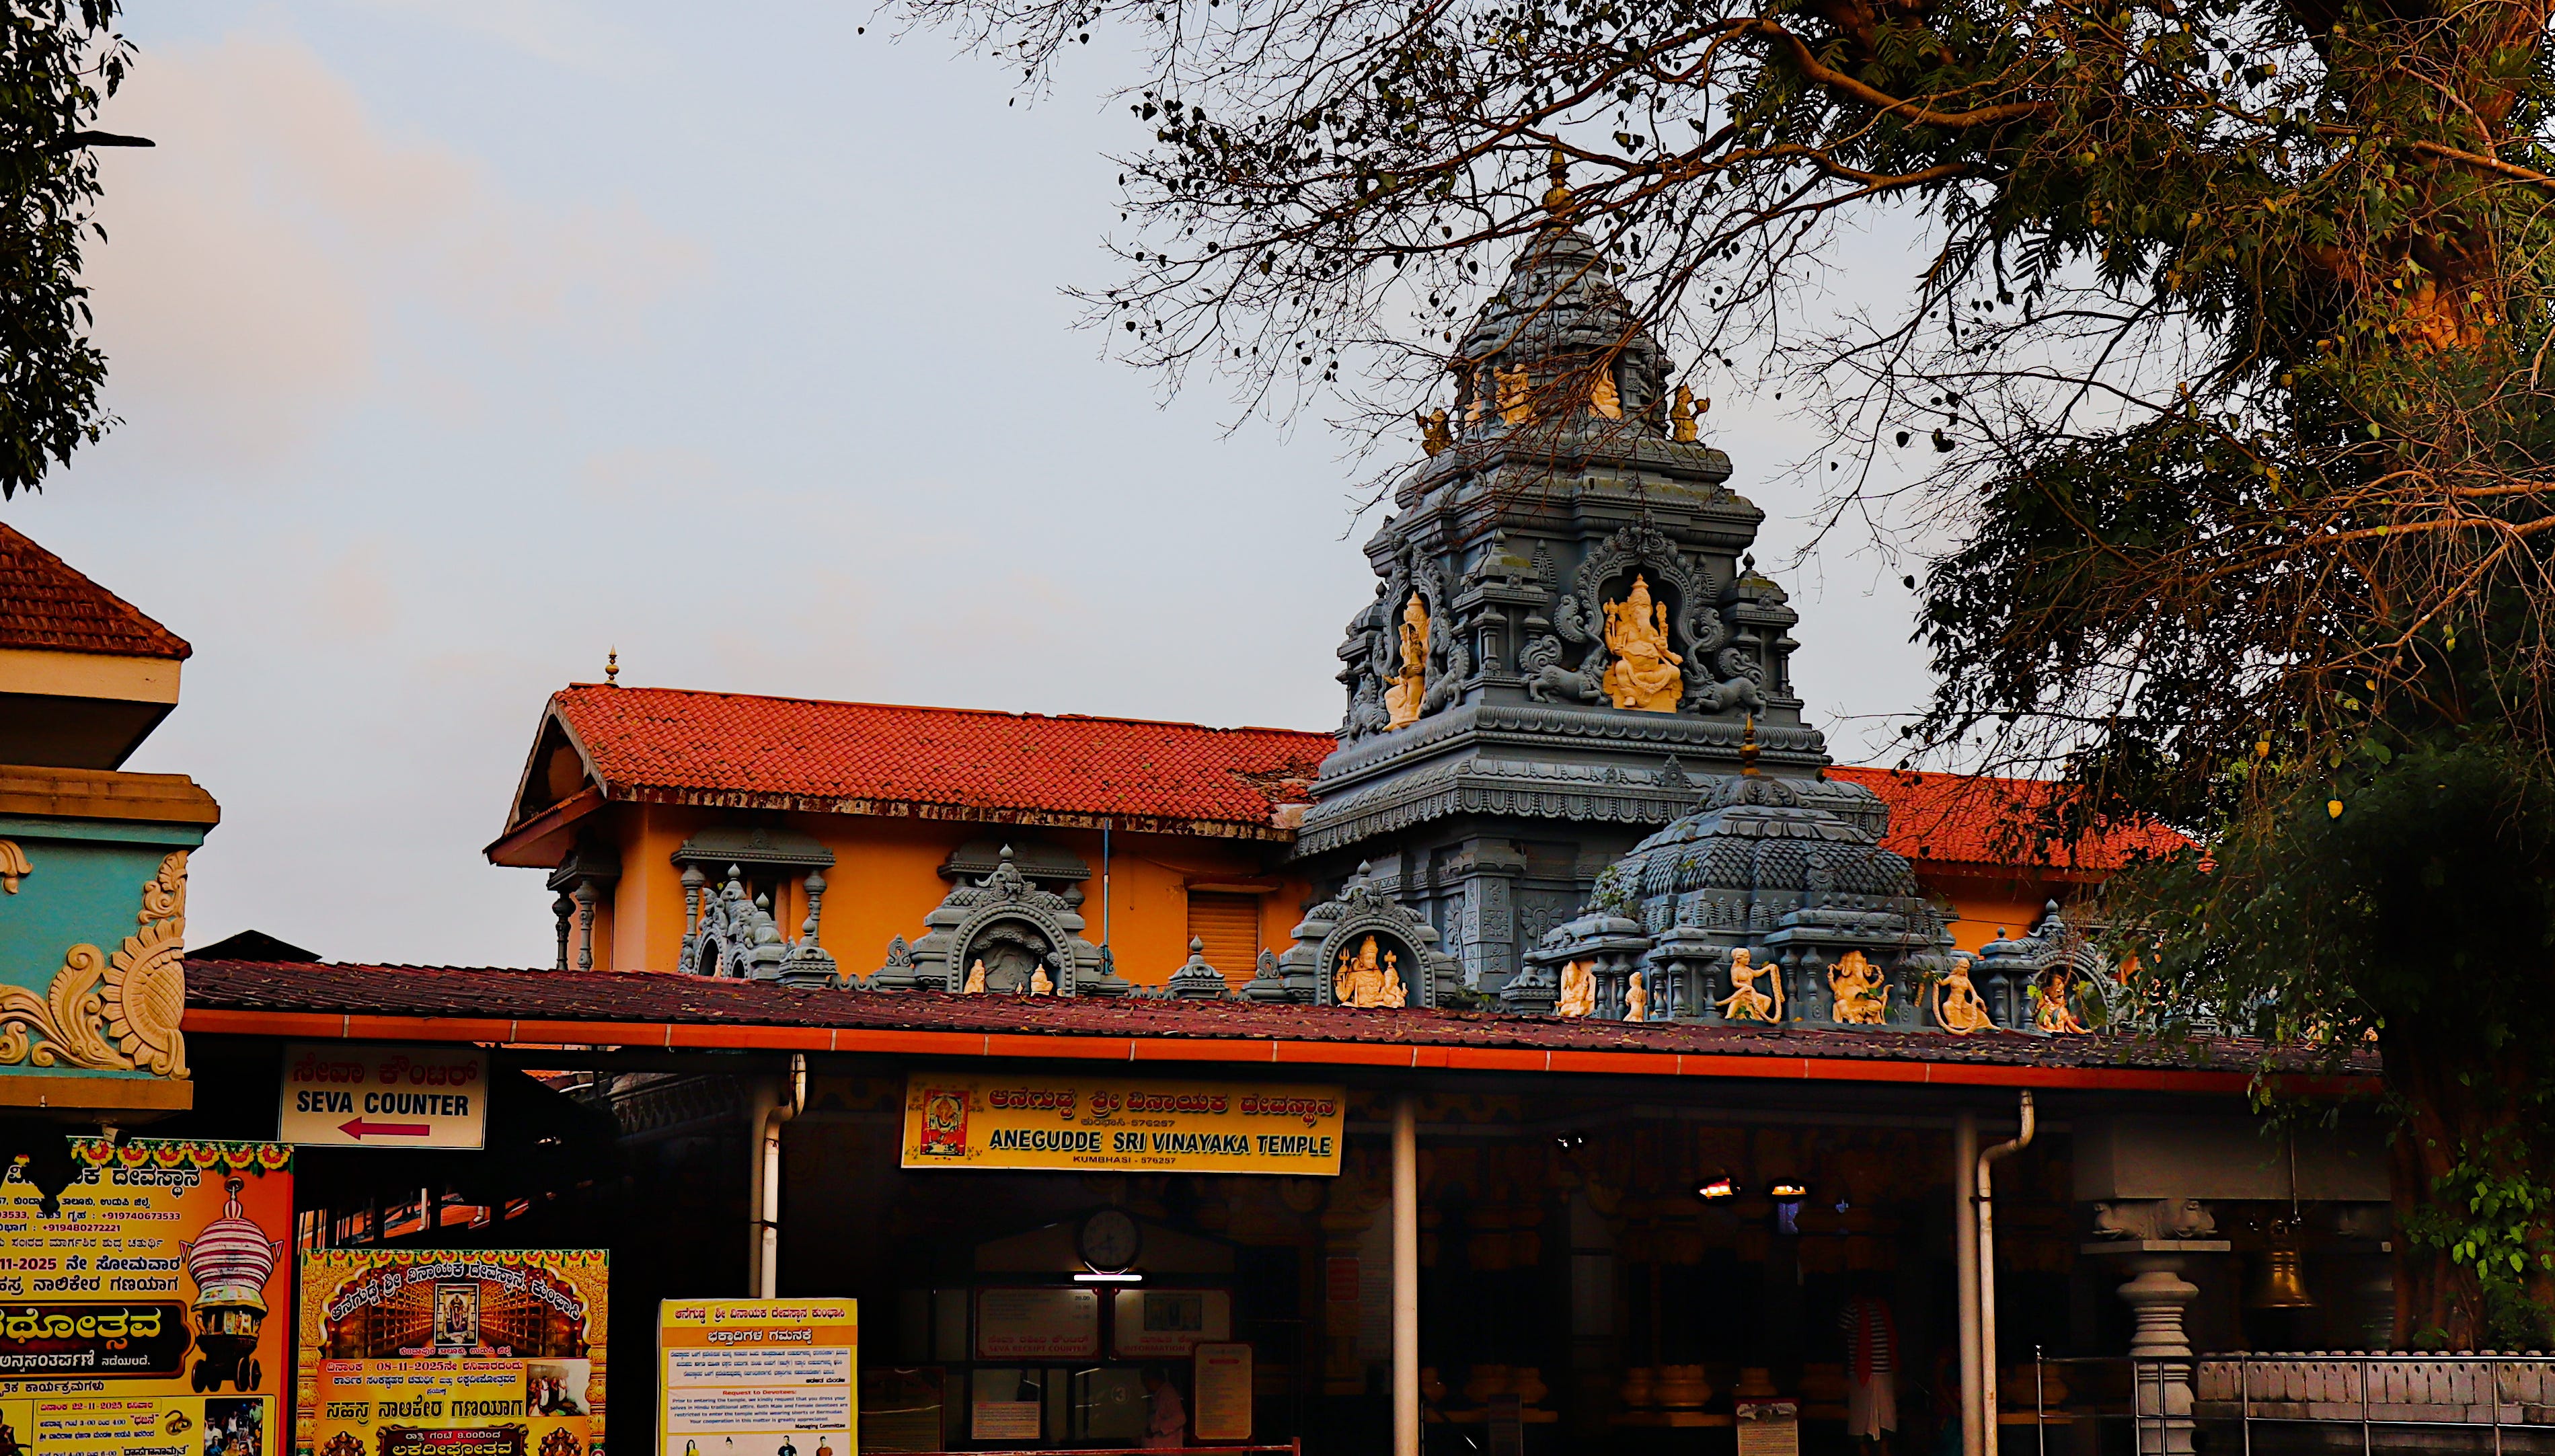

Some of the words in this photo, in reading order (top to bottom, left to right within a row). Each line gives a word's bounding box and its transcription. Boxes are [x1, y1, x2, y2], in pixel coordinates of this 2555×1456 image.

[293, 1052, 365, 1083] ಸೇವಾ
[379, 1055, 478, 1086] ಕೌಂಟರ್
[297, 1091, 353, 1113] SEVA
[365, 1093, 469, 1116] COUNTER
[989, 1087, 1076, 1119] ಆನೆಗುಡ್ಡೆ
[1089, 1089, 1120, 1118] ಶ್ರೀ
[1127, 1091, 1229, 1114] ವಿನಾಯಕ
[1240, 1092, 1336, 1127] ದೇವಸ್ಥಾನ
[989, 1129, 1102, 1151] ANEGUDDE
[1113, 1132, 1147, 1152] SRI
[1153, 1133, 1250, 1155] VINAYAKA
[1257, 1135, 1332, 1157] TEMPLE
[112, 1165, 201, 1197] ದೇವಸ್ಥಾನ
[67, 1255, 87, 1270] ನೇ
[96, 1255, 180, 1271] ಸೋಮವಾರ
[34, 1275, 100, 1291] ನಾಲಿಕೇರ
[110, 1276, 178, 1291] ಗಣಯಾಗ
[383, 1274, 402, 1297] ಶ್ರೀ
[407, 1260, 464, 1284] ವಿನಾಯಕ
[327, 1402, 370, 1424] ಸಹಸ್ರ
[378, 1395, 443, 1418] ನಾಲಿಕೇರ
[452, 1400, 524, 1418] ಗಣಯಾಗ
